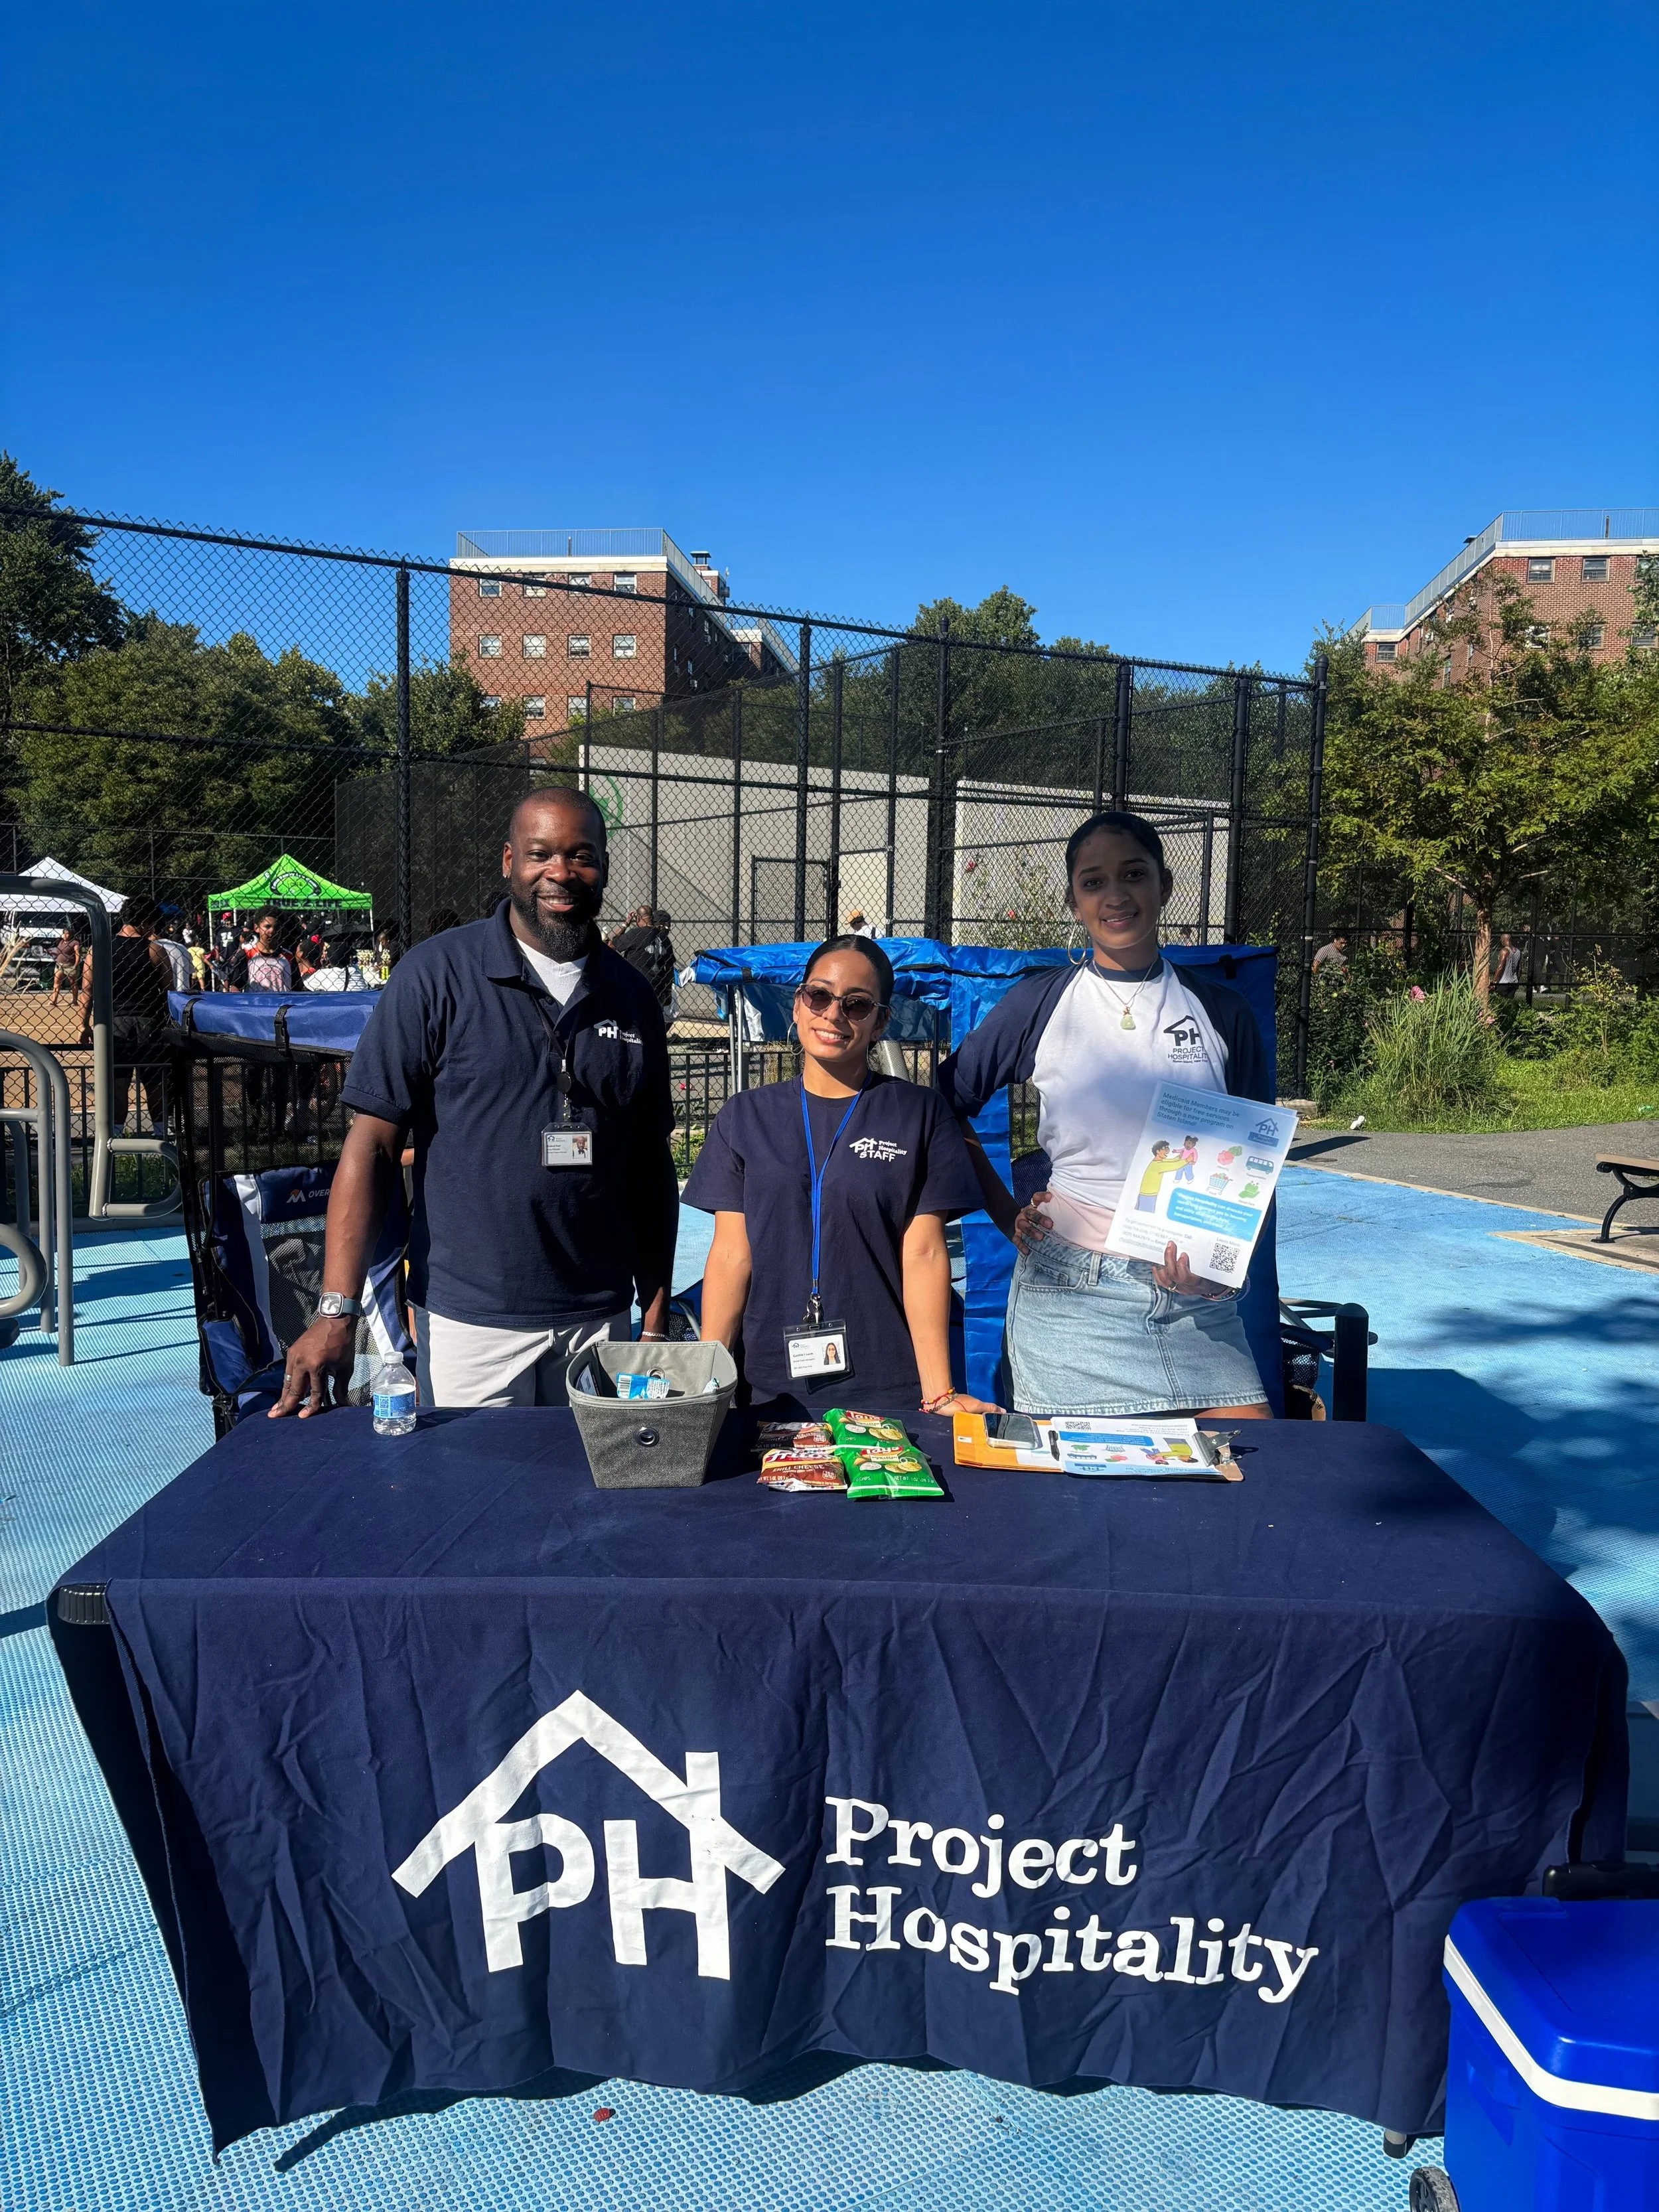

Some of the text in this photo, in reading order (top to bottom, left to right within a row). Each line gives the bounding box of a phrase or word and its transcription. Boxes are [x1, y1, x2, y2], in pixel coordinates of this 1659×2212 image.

[1161, 1100, 1183, 1109] eligible
[1206, 1112, 1230, 1122] services
[1163, 1092, 1189, 1104] Medicaid
[1190, 1100, 1218, 1112] Members
[1157, 1112, 1177, 1122] Staten
[1159, 1105, 1182, 1116] through
[1200, 1118, 1225, 1128] program
[859, 1150, 896, 1162] STAFF
[879, 1145, 907, 1155] Hospitality
[308, 1189, 330, 1198] OVER
[825, 1796, 1137, 1899] Project
[825, 1884, 1319, 2004] Hospitality
